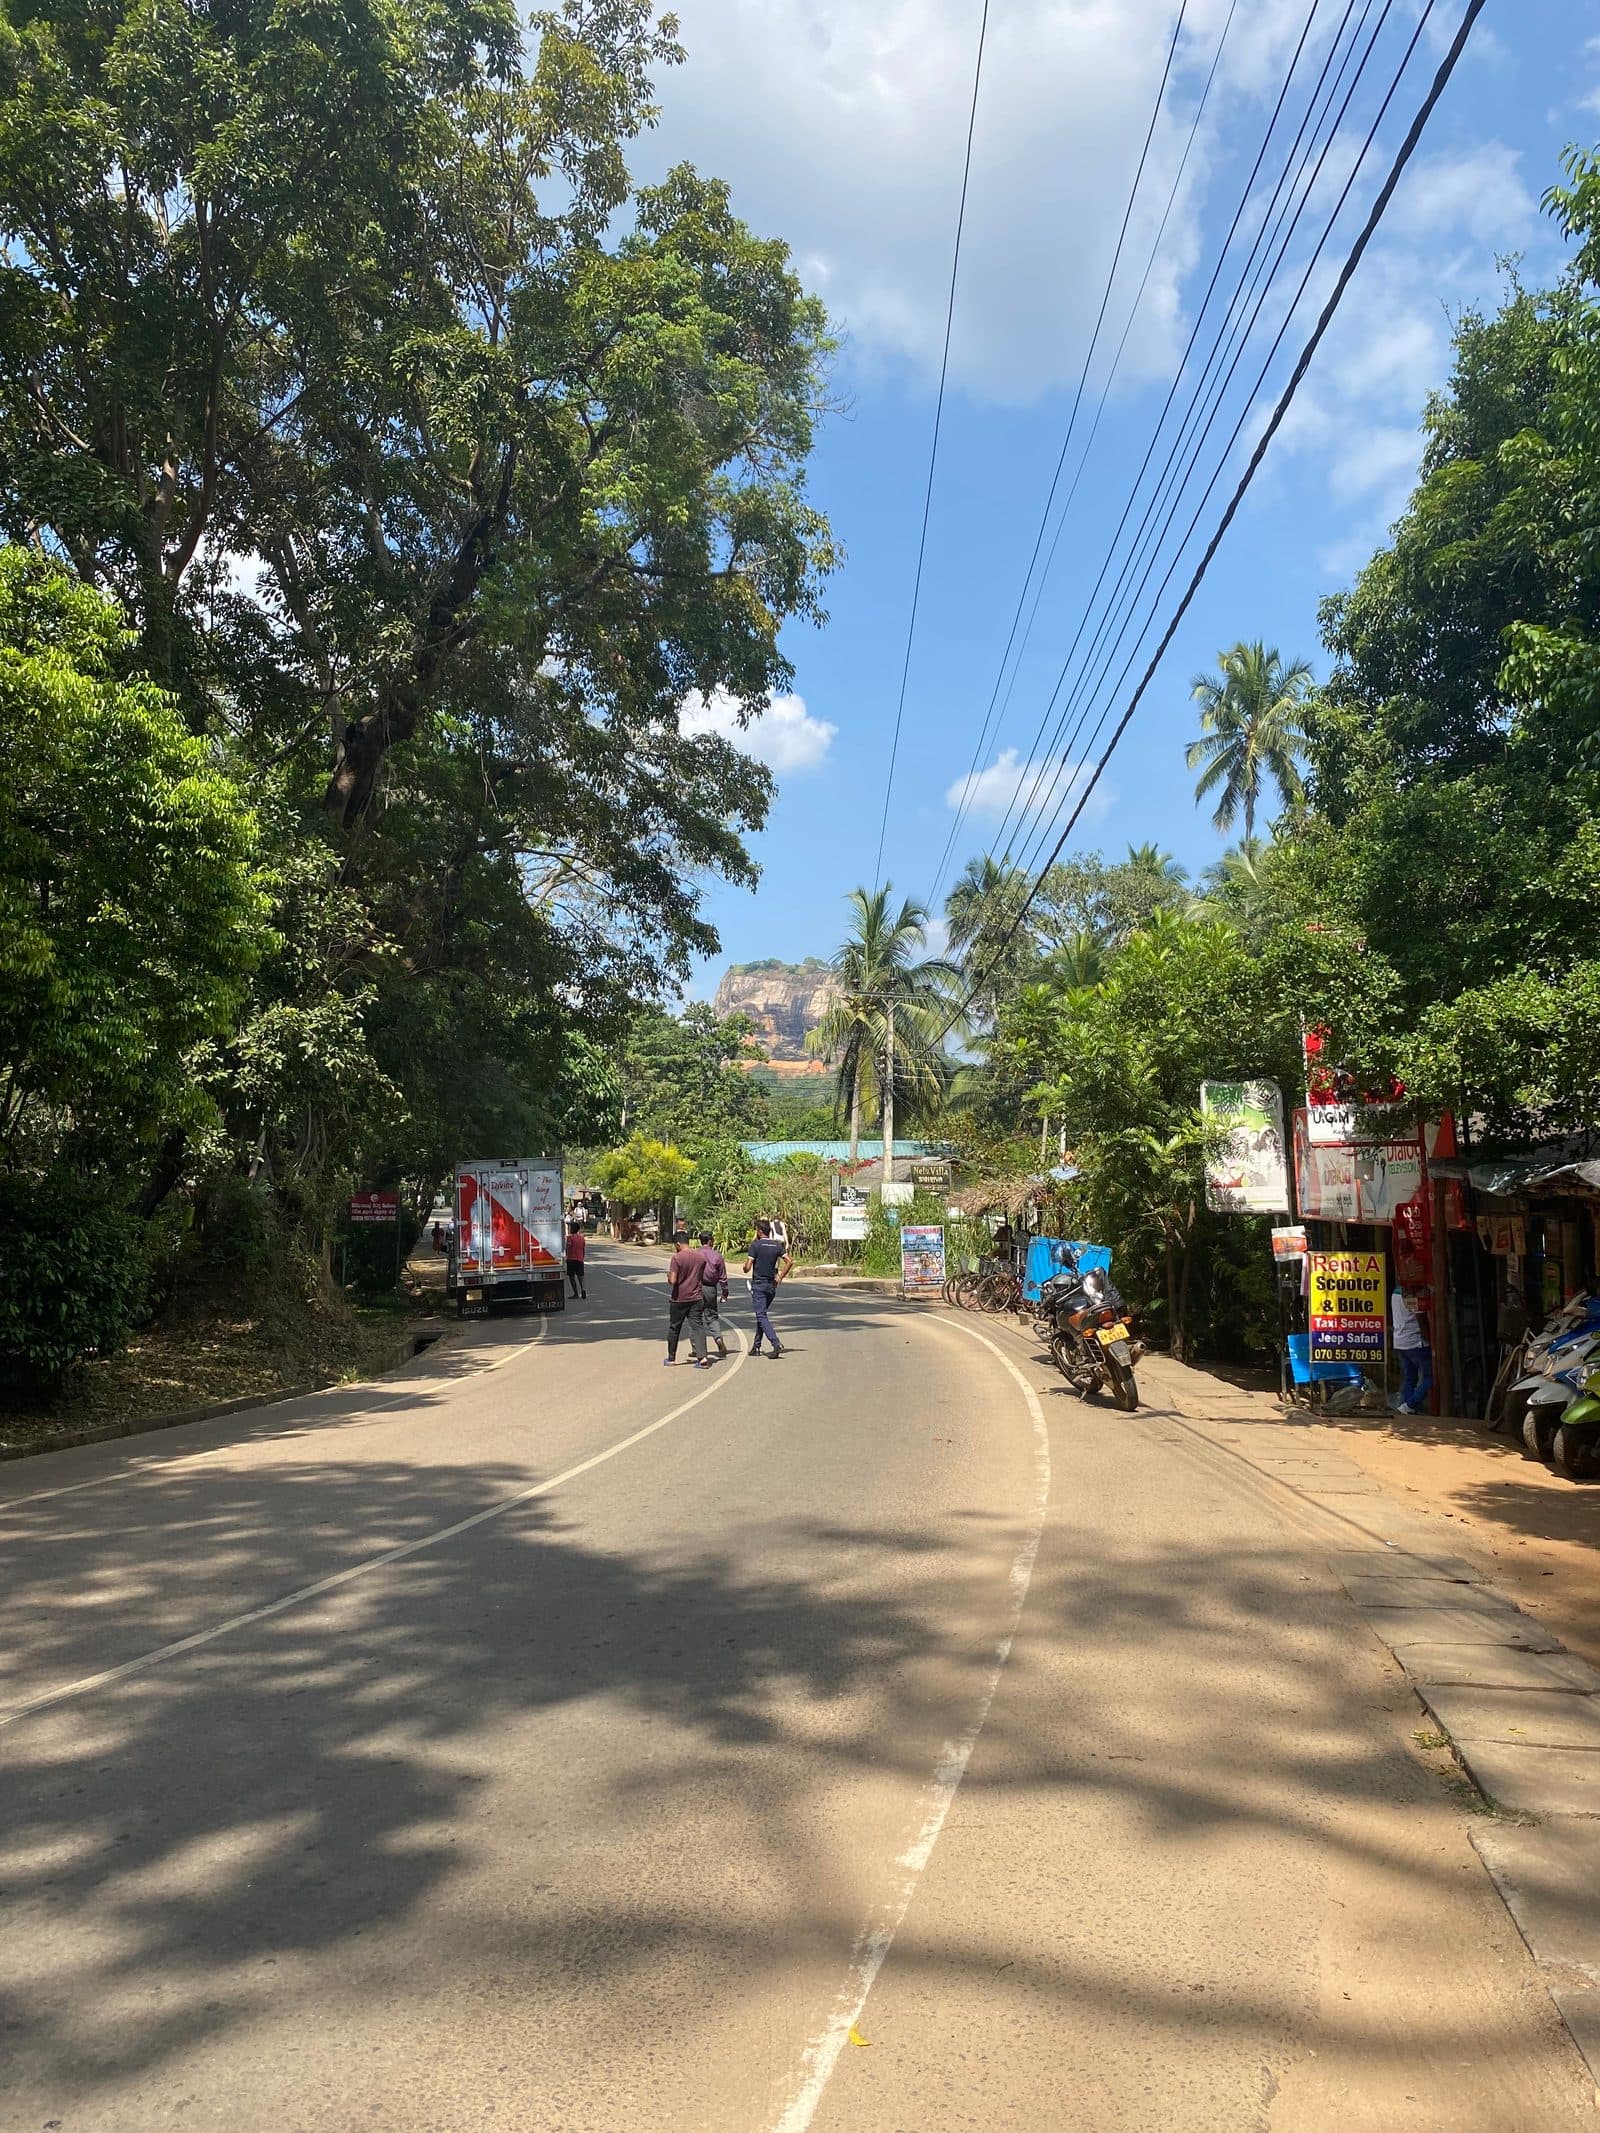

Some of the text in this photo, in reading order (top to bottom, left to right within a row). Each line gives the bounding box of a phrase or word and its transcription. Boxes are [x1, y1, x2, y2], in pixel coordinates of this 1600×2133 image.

[1313, 1255, 1380, 1272] Rent A
[1316, 1276, 1380, 1292] Scooter
[1323, 1297, 1374, 1313] & Bike
[1314, 1317, 1381, 1328] Taxi Service
[1318, 1332, 1379, 1345] Jeep Safari
[1314, 1349, 1382, 1360] 070 55 760 96
